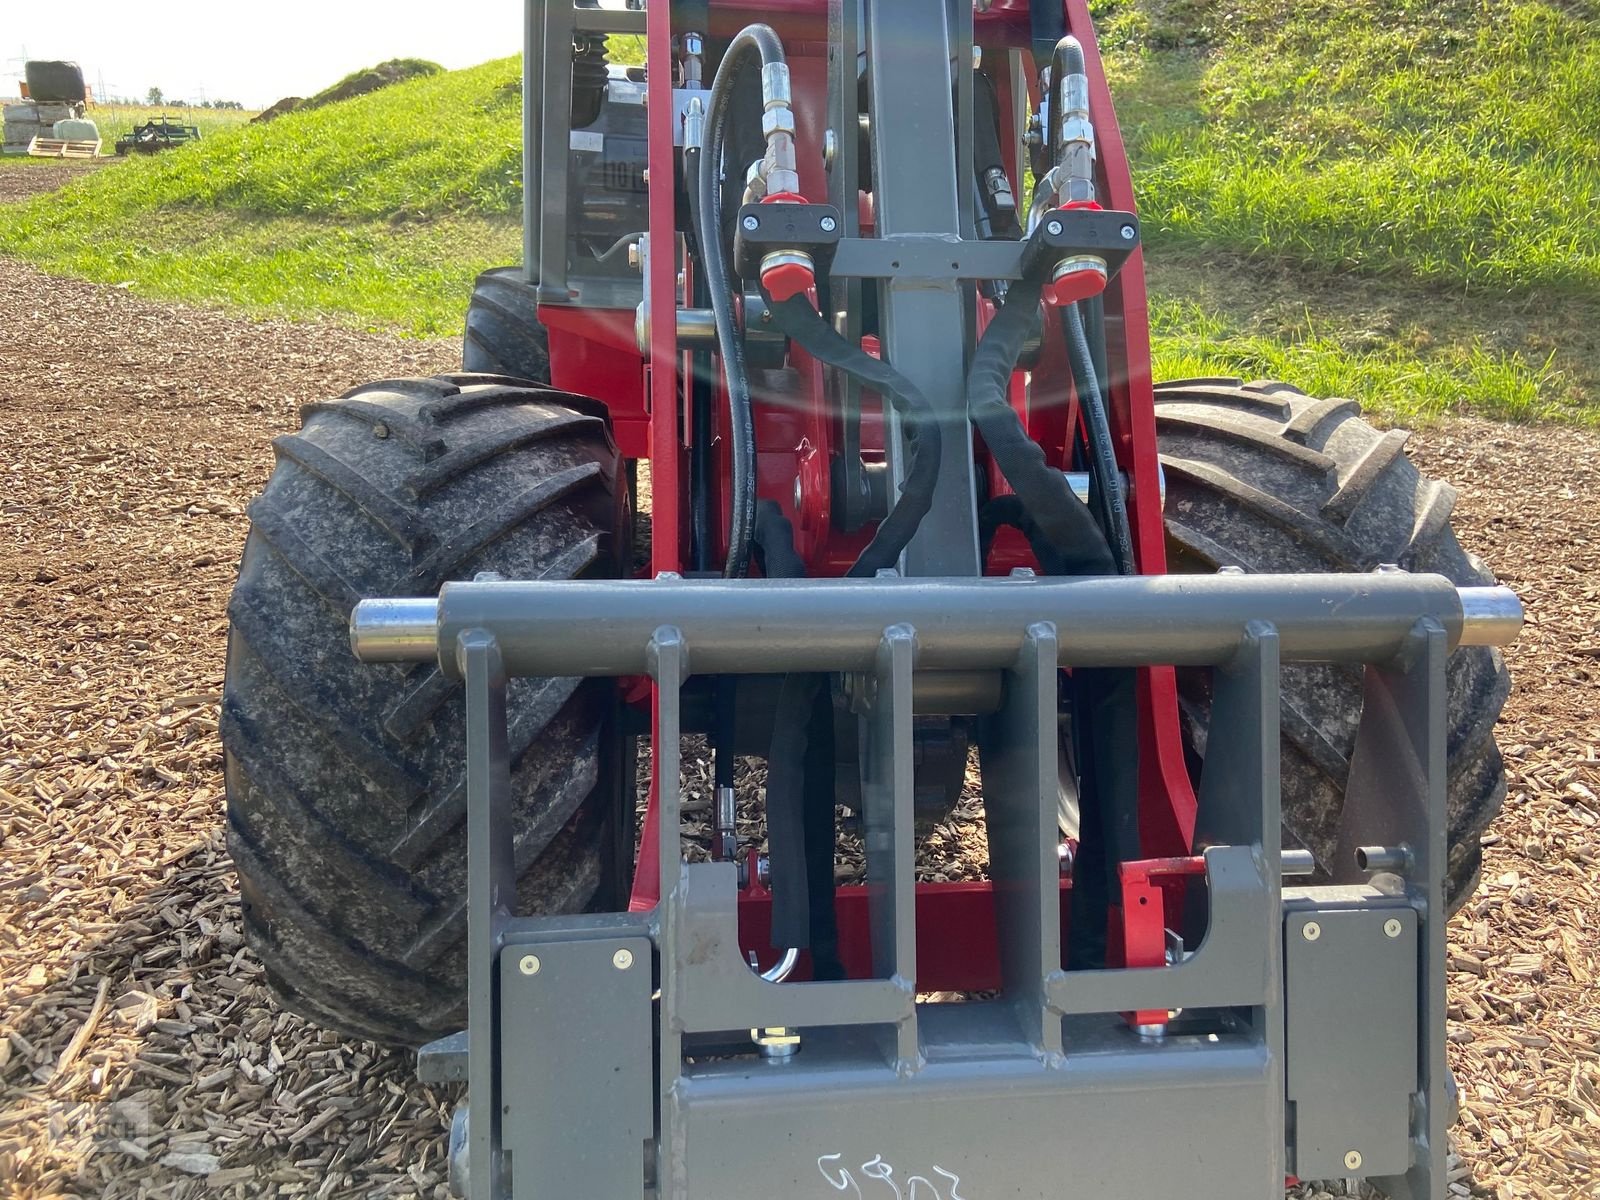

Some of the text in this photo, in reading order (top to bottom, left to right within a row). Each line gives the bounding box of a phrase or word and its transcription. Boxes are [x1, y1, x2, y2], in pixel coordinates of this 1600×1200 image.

[745, 422, 753, 434] 10
[1104, 450, 1113, 462] 10
[1109, 480, 1118, 492] 10
[1113, 499, 1122, 513] DN
